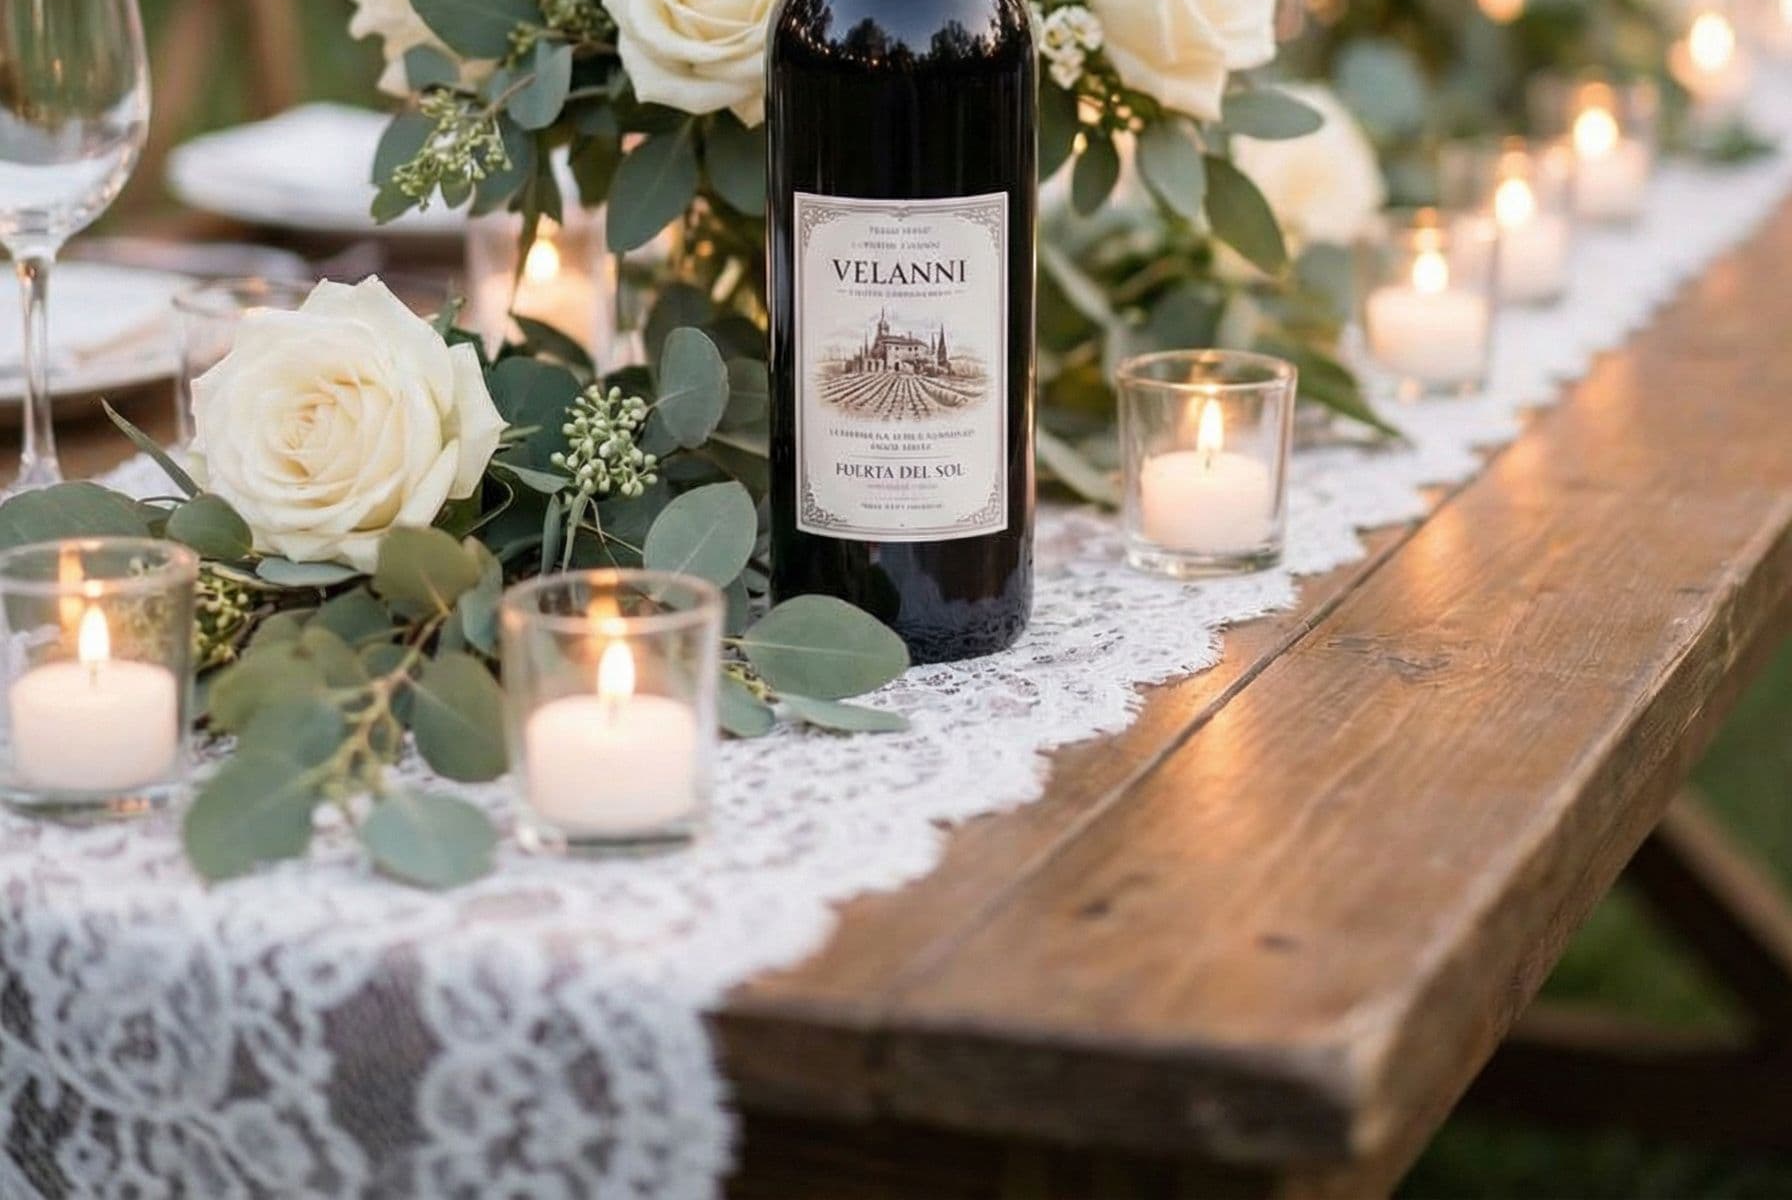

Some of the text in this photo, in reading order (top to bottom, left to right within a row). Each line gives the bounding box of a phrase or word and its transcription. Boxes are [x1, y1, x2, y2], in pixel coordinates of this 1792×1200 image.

[833, 259, 967, 285] VELANNI
[900, 465, 931, 479] DEL
[934, 463, 966, 478] SOL
